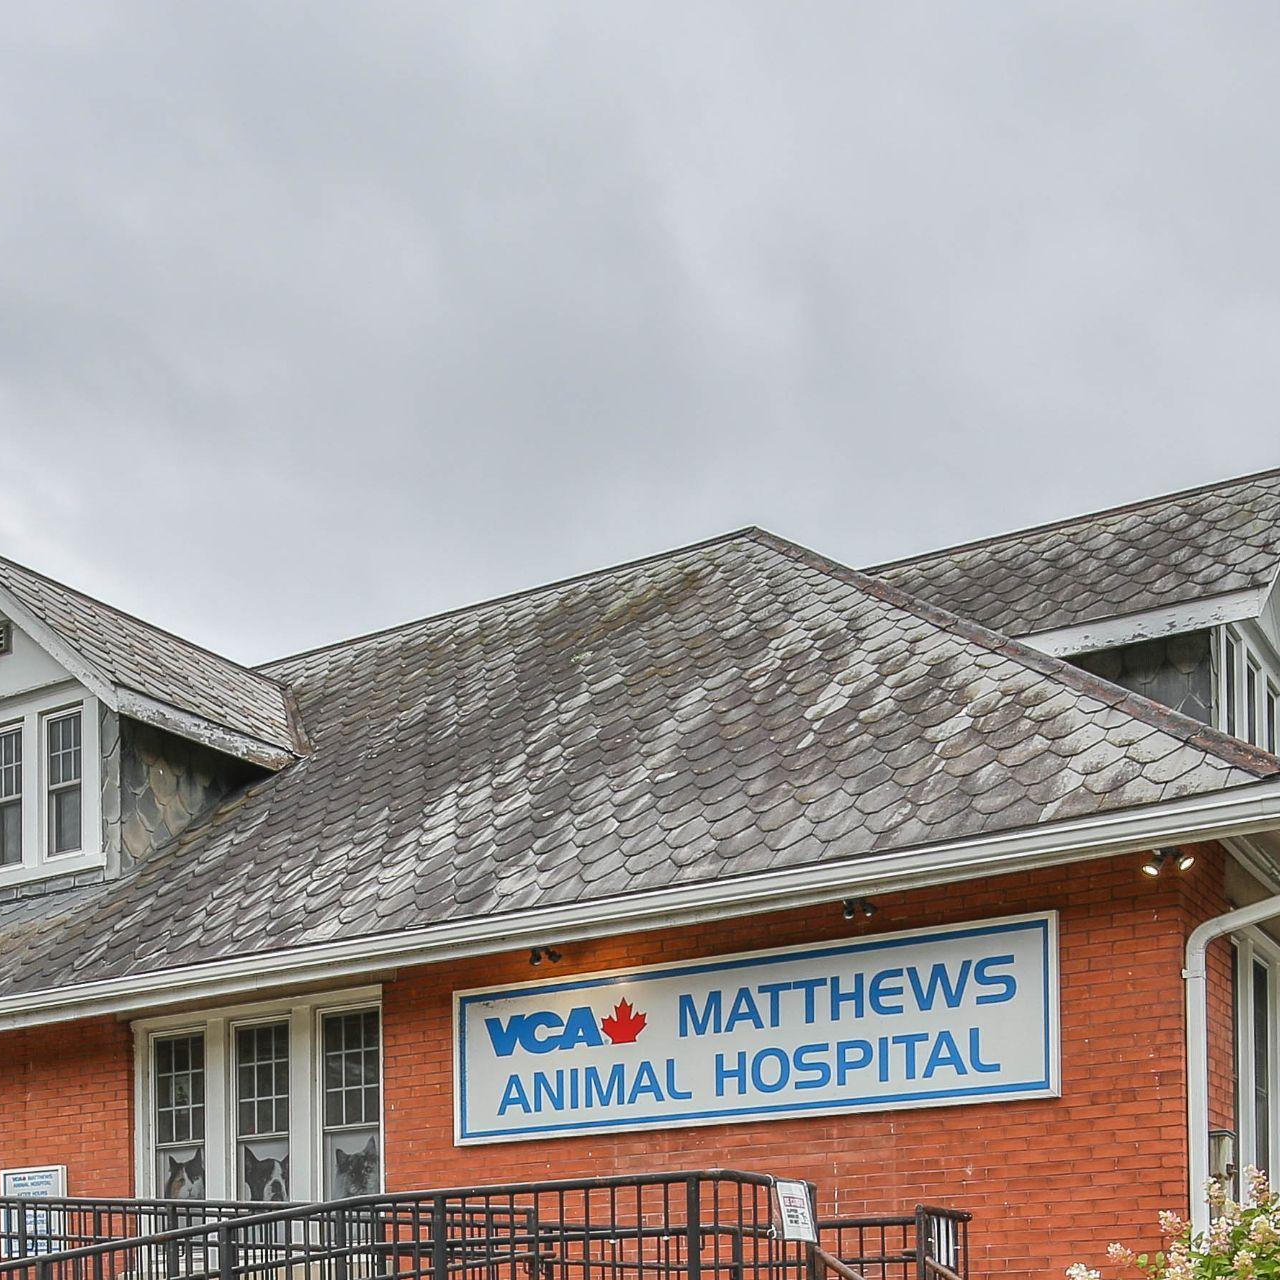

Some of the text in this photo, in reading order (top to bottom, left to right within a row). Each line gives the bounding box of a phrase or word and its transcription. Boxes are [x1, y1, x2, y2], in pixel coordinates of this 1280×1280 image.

[485, 955, 1017, 1057] VCA MATTHEWS
[498, 1027, 1001, 1117] ANIMAL HOSPITAL
